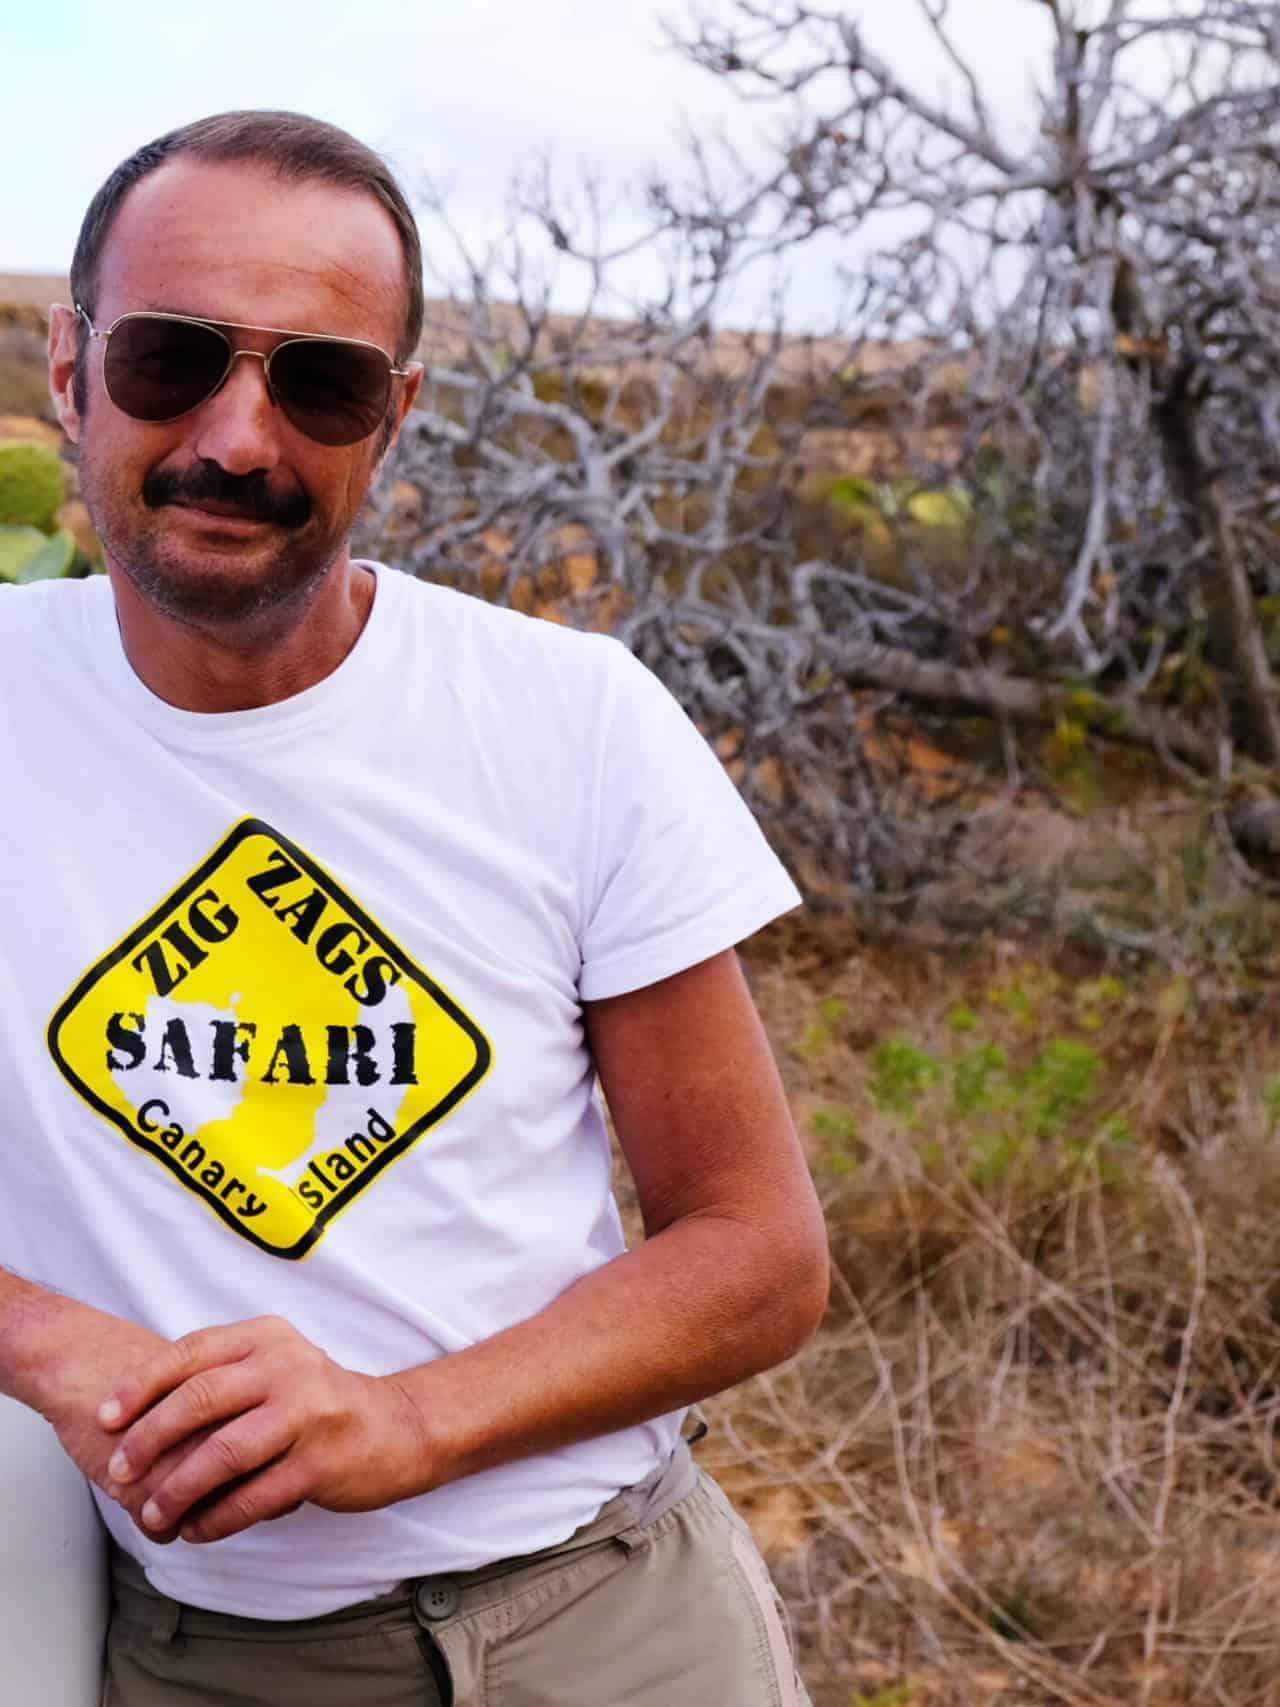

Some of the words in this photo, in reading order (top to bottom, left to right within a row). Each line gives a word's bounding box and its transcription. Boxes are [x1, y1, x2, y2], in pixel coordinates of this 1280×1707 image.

[132, 889, 239, 997] ZIG
[247, 850, 401, 1006] ZAGS
[105, 1012, 419, 1086] SAFARI
[137, 1098, 267, 1217] Canary
[292, 1107, 397, 1211] sland
